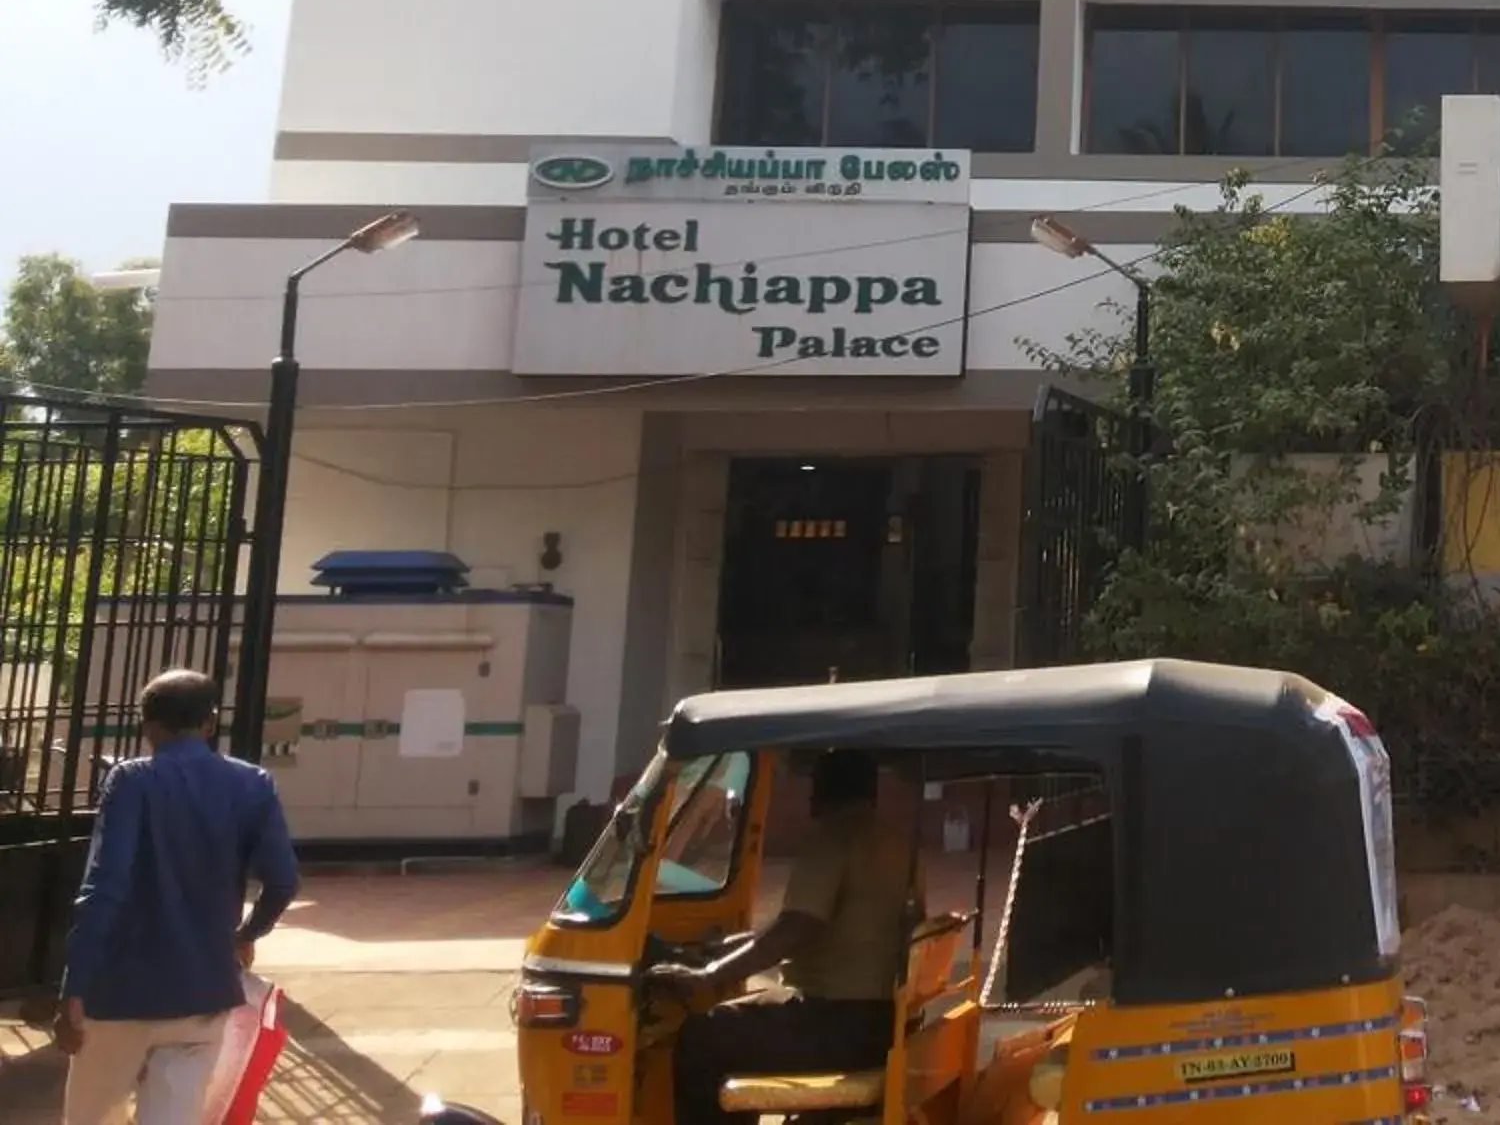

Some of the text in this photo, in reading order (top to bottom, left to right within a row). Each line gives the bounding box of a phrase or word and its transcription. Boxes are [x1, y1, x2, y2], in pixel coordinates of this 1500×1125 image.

[624, 148, 961, 185] நாச்சியப்பா பேலஸ்
[545, 217, 700, 252] Hotel
[544, 262, 942, 315] Nachiappa
[751, 326, 941, 360] Palace
